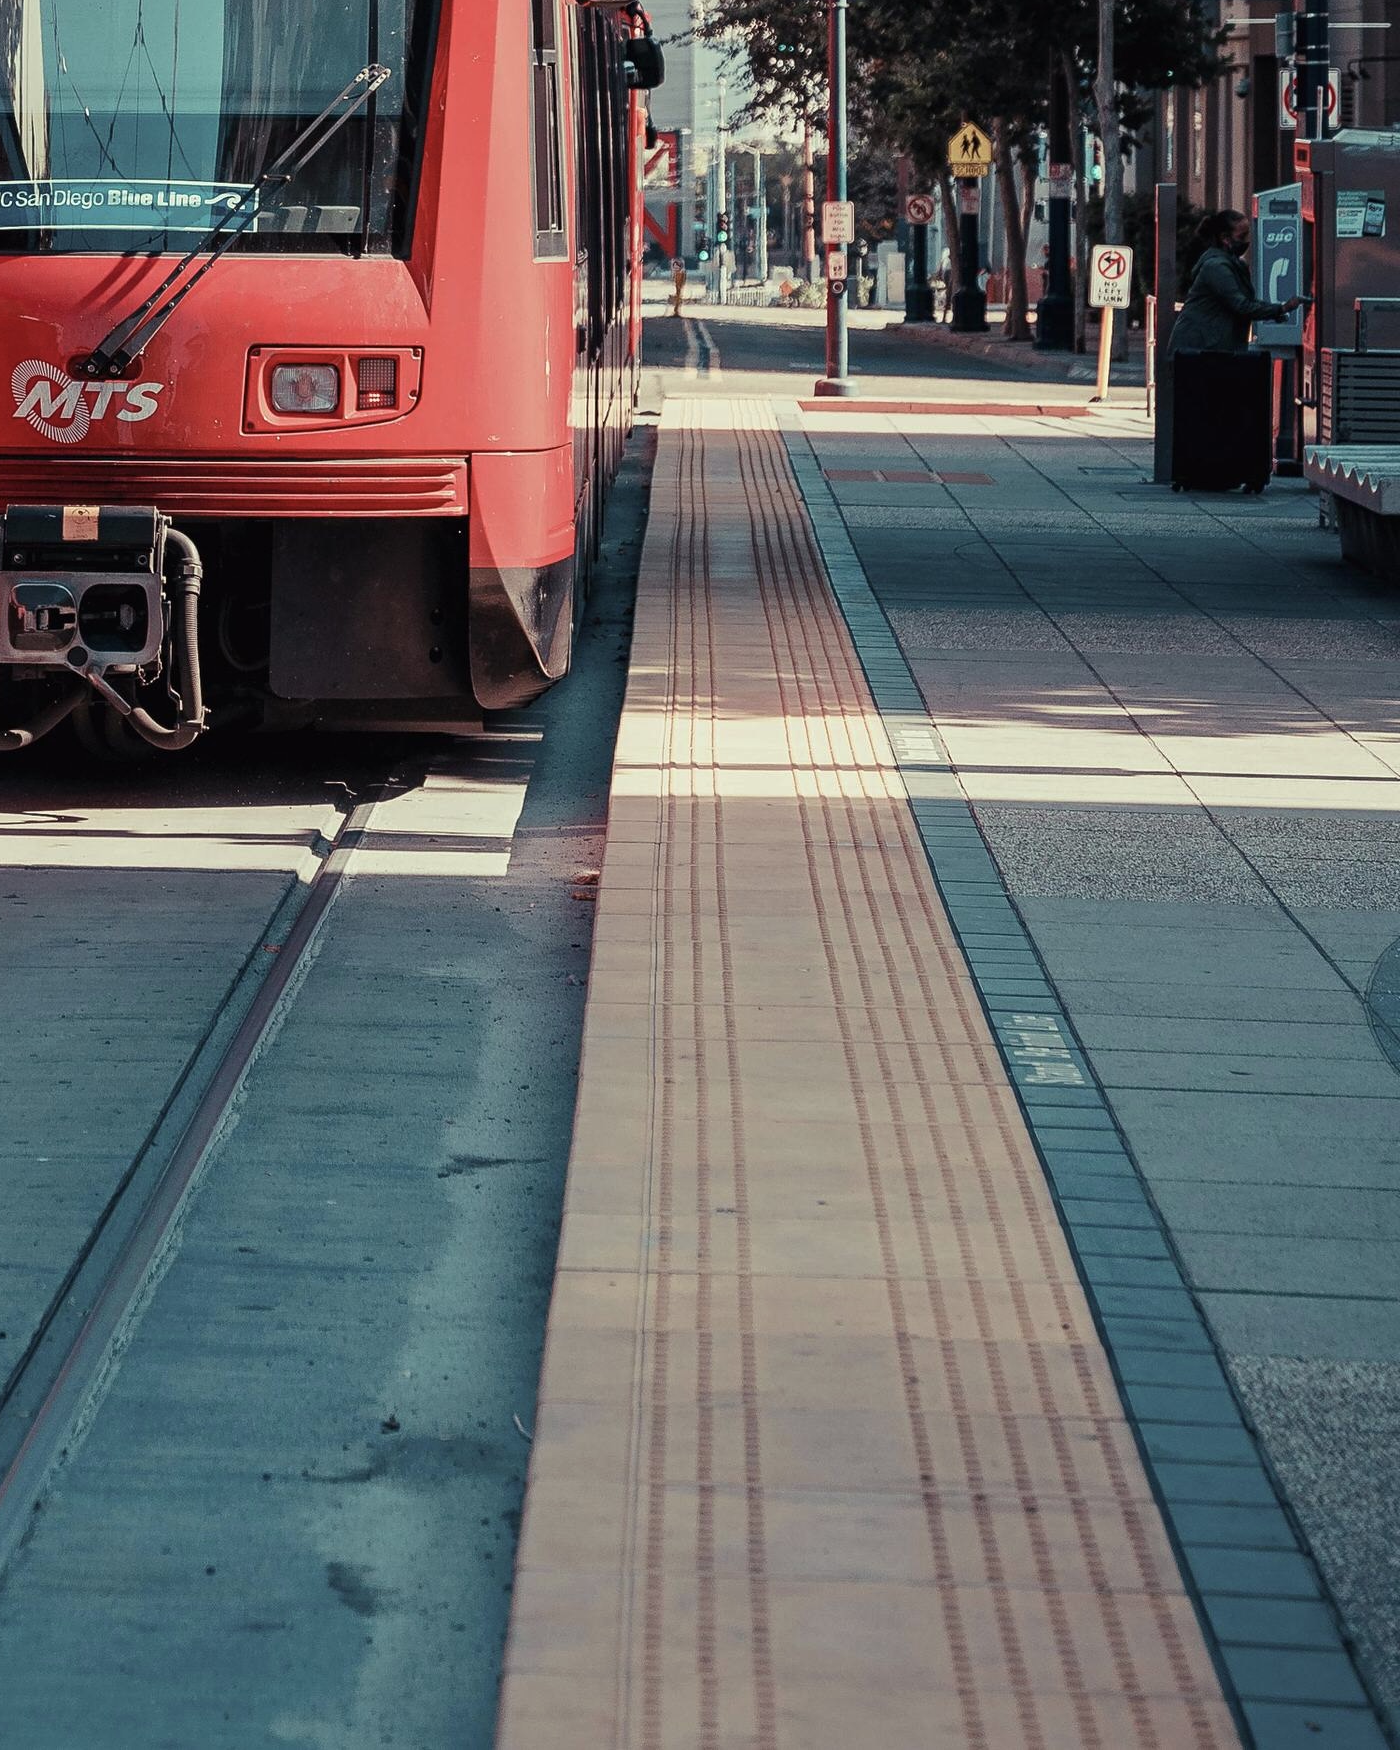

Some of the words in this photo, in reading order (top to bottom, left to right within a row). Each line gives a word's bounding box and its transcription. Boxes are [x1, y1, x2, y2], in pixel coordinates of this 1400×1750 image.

[15, 191, 50, 207] San
[53, 190, 104, 210] Diego
[107, 190, 153, 206] Blue
[157, 191, 202, 207] Line
[13, 381, 165, 422] MTS
